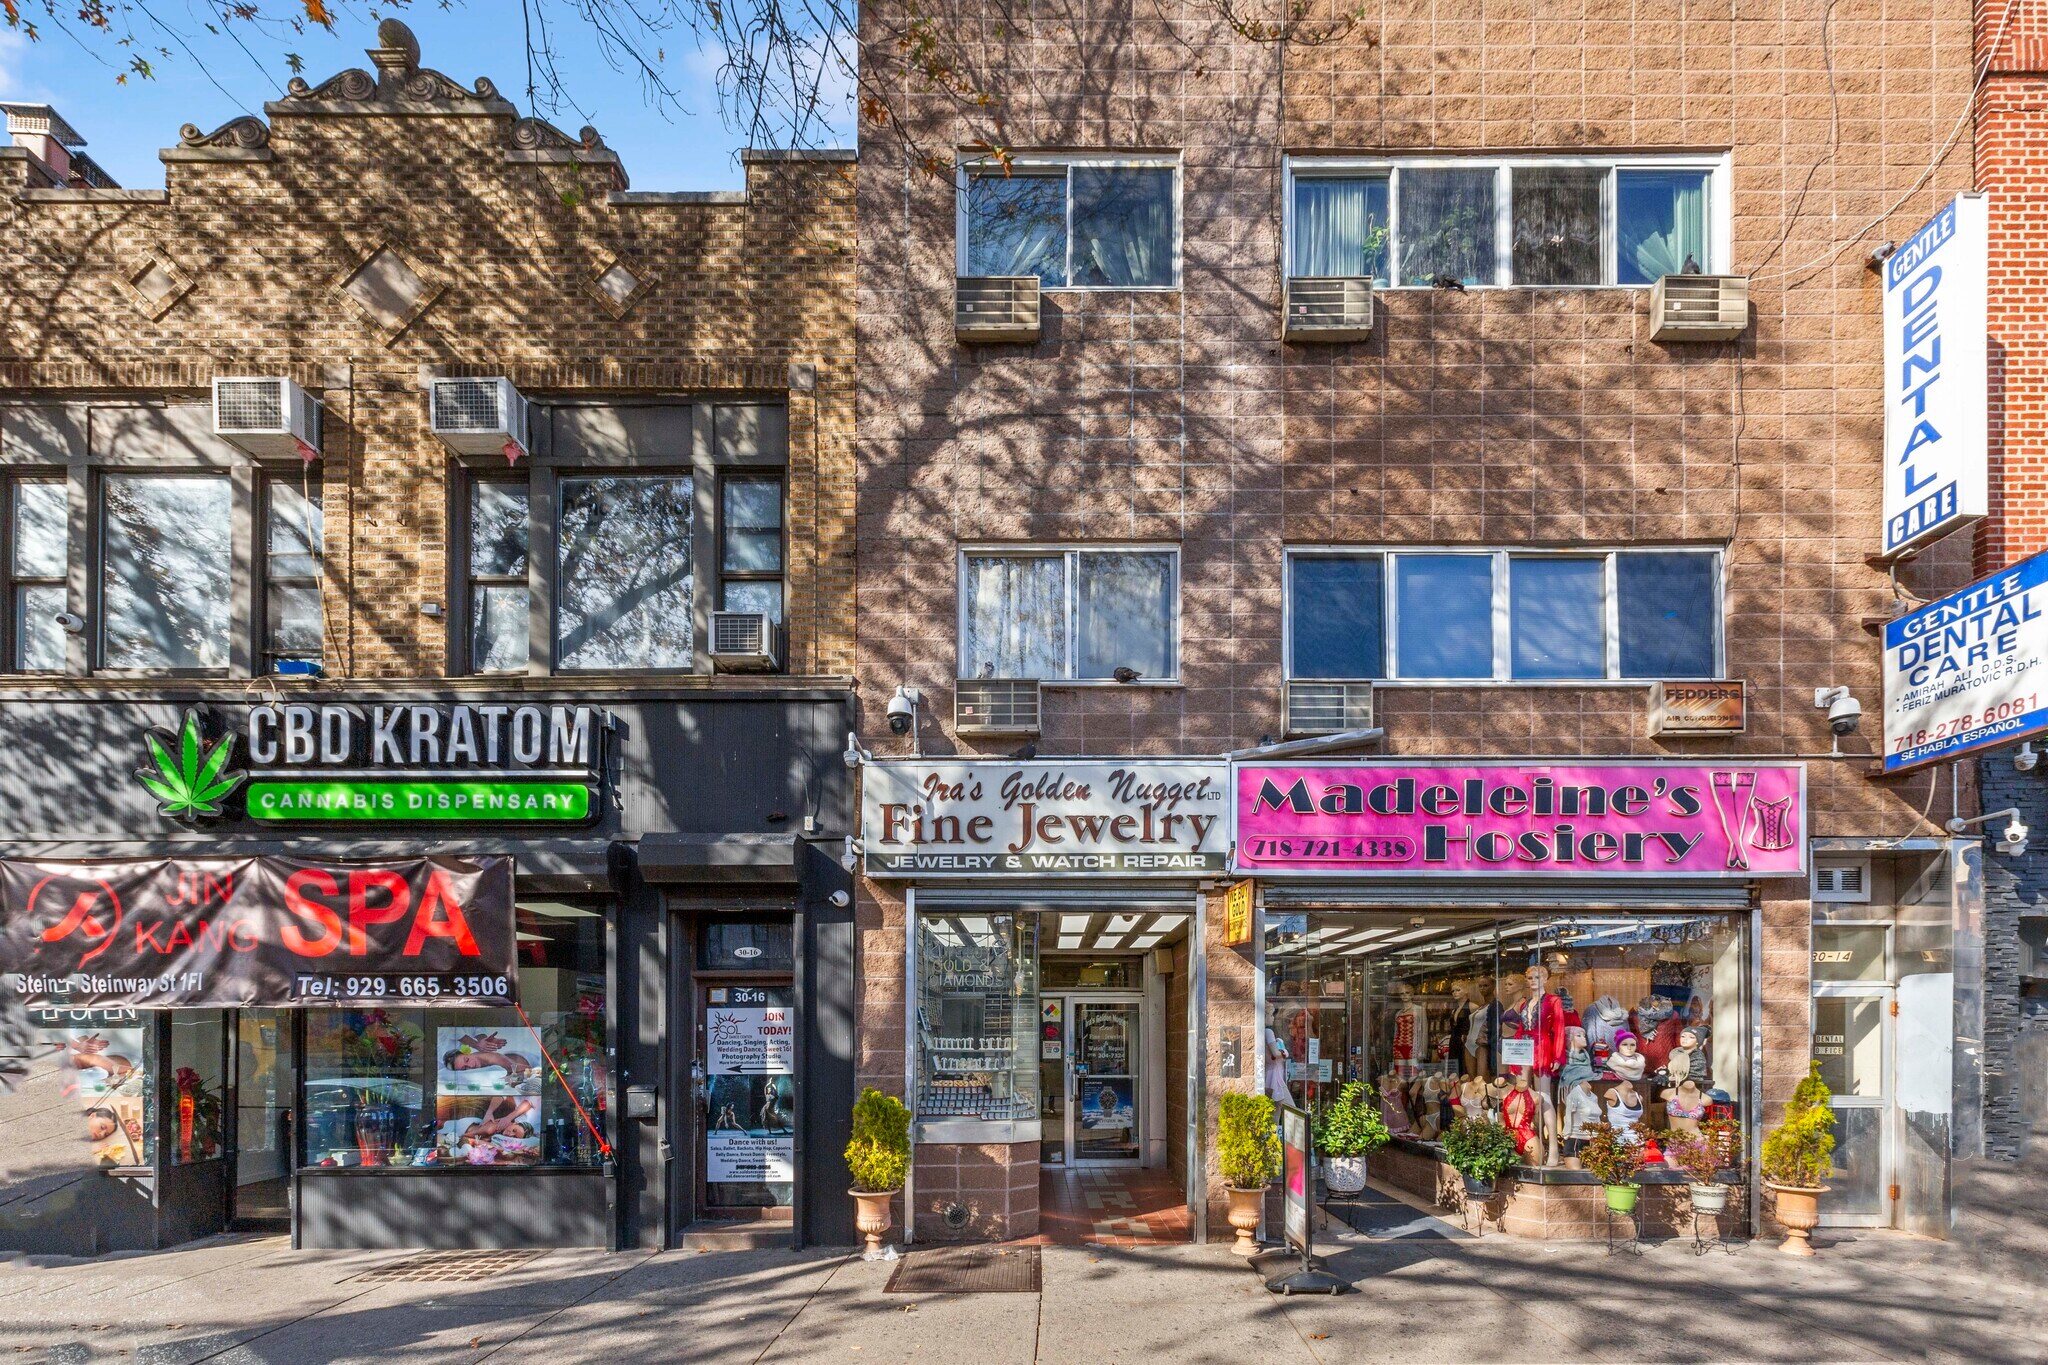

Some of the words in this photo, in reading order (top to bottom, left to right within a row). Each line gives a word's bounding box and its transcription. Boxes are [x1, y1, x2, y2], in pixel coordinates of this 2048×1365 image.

[1893, 212, 1952, 282] GENTLE
[1899, 265, 1942, 498] DENTAL
[1892, 487, 1953, 542] CARE
[1903, 571, 2023, 639] GENTLE
[1899, 593, 2042, 673] DENTAL
[1908, 629, 2018, 687] CARE
[1665, 688, 1740, 700] FEDDERS
[1902, 679, 1945, 702] AMIRAH
[1954, 670, 1972, 685] ALI
[1981, 655, 2017, 675] D.D.S.
[1902, 696, 1931, 713] FERIZ
[1934, 668, 2001, 702] MURATOVIC
[2005, 657, 2042, 677] R.D.H.
[249, 705, 350, 764] CBD
[373, 705, 591, 764] KRATOM
[1893, 692, 2039, 753] 718-278-6081
[1900, 749, 1916, 762] SE
[1918, 737, 1959, 757] HABLA
[1961, 718, 2025, 743] ESPAÑOL
[260, 793, 395, 809] CANNABIS
[408, 793, 574, 809] DISPENSARY
[922, 771, 984, 802] Ira's
[1000, 770, 1091, 812] Golden
[1107, 769, 1211, 811] Nugget
[1207, 791, 1222, 801] LTD
[1251, 776, 1703, 816] Madeleine's
[879, 803, 994, 845] Fine
[1008, 802, 1218, 855] Jewelry
[1423, 823, 1705, 863] Hosiery
[886, 855, 998, 869] JEWELRY
[1005, 856, 1023, 868] &
[1031, 855, 1116, 868] WATCH
[1123, 855, 1207, 868] REPAIR
[1252, 839, 1408, 857] 718-721-4338
[165, 871, 234, 906] JIN
[280, 868, 481, 958] SPA
[134, 918, 260, 954] KANG
[80, 973, 158, 997] Steinway
[158, 973, 177, 993] St
[297, 976, 341, 996] Tel:
[735, 992, 765, 1002] 30-16
[718, 1024, 742, 1040] SOL
[757, 1026, 792, 1035] TODAY!
[763, 1012, 785, 1021] JOIN
[717, 1039, 743, 1048] Dancing,
[743, 1039, 769, 1048] Singing,
[769, 1039, 791, 1048] Acting,
[717, 1046, 743, 1054] Wedding
[721, 1053, 761, 1062] Photography
[1815, 1035, 1844, 1044] DENTAL
[728, 1138, 750, 1146] Dance
[750, 1138, 766, 1146] with
[766, 1138, 778, 1146] us!
